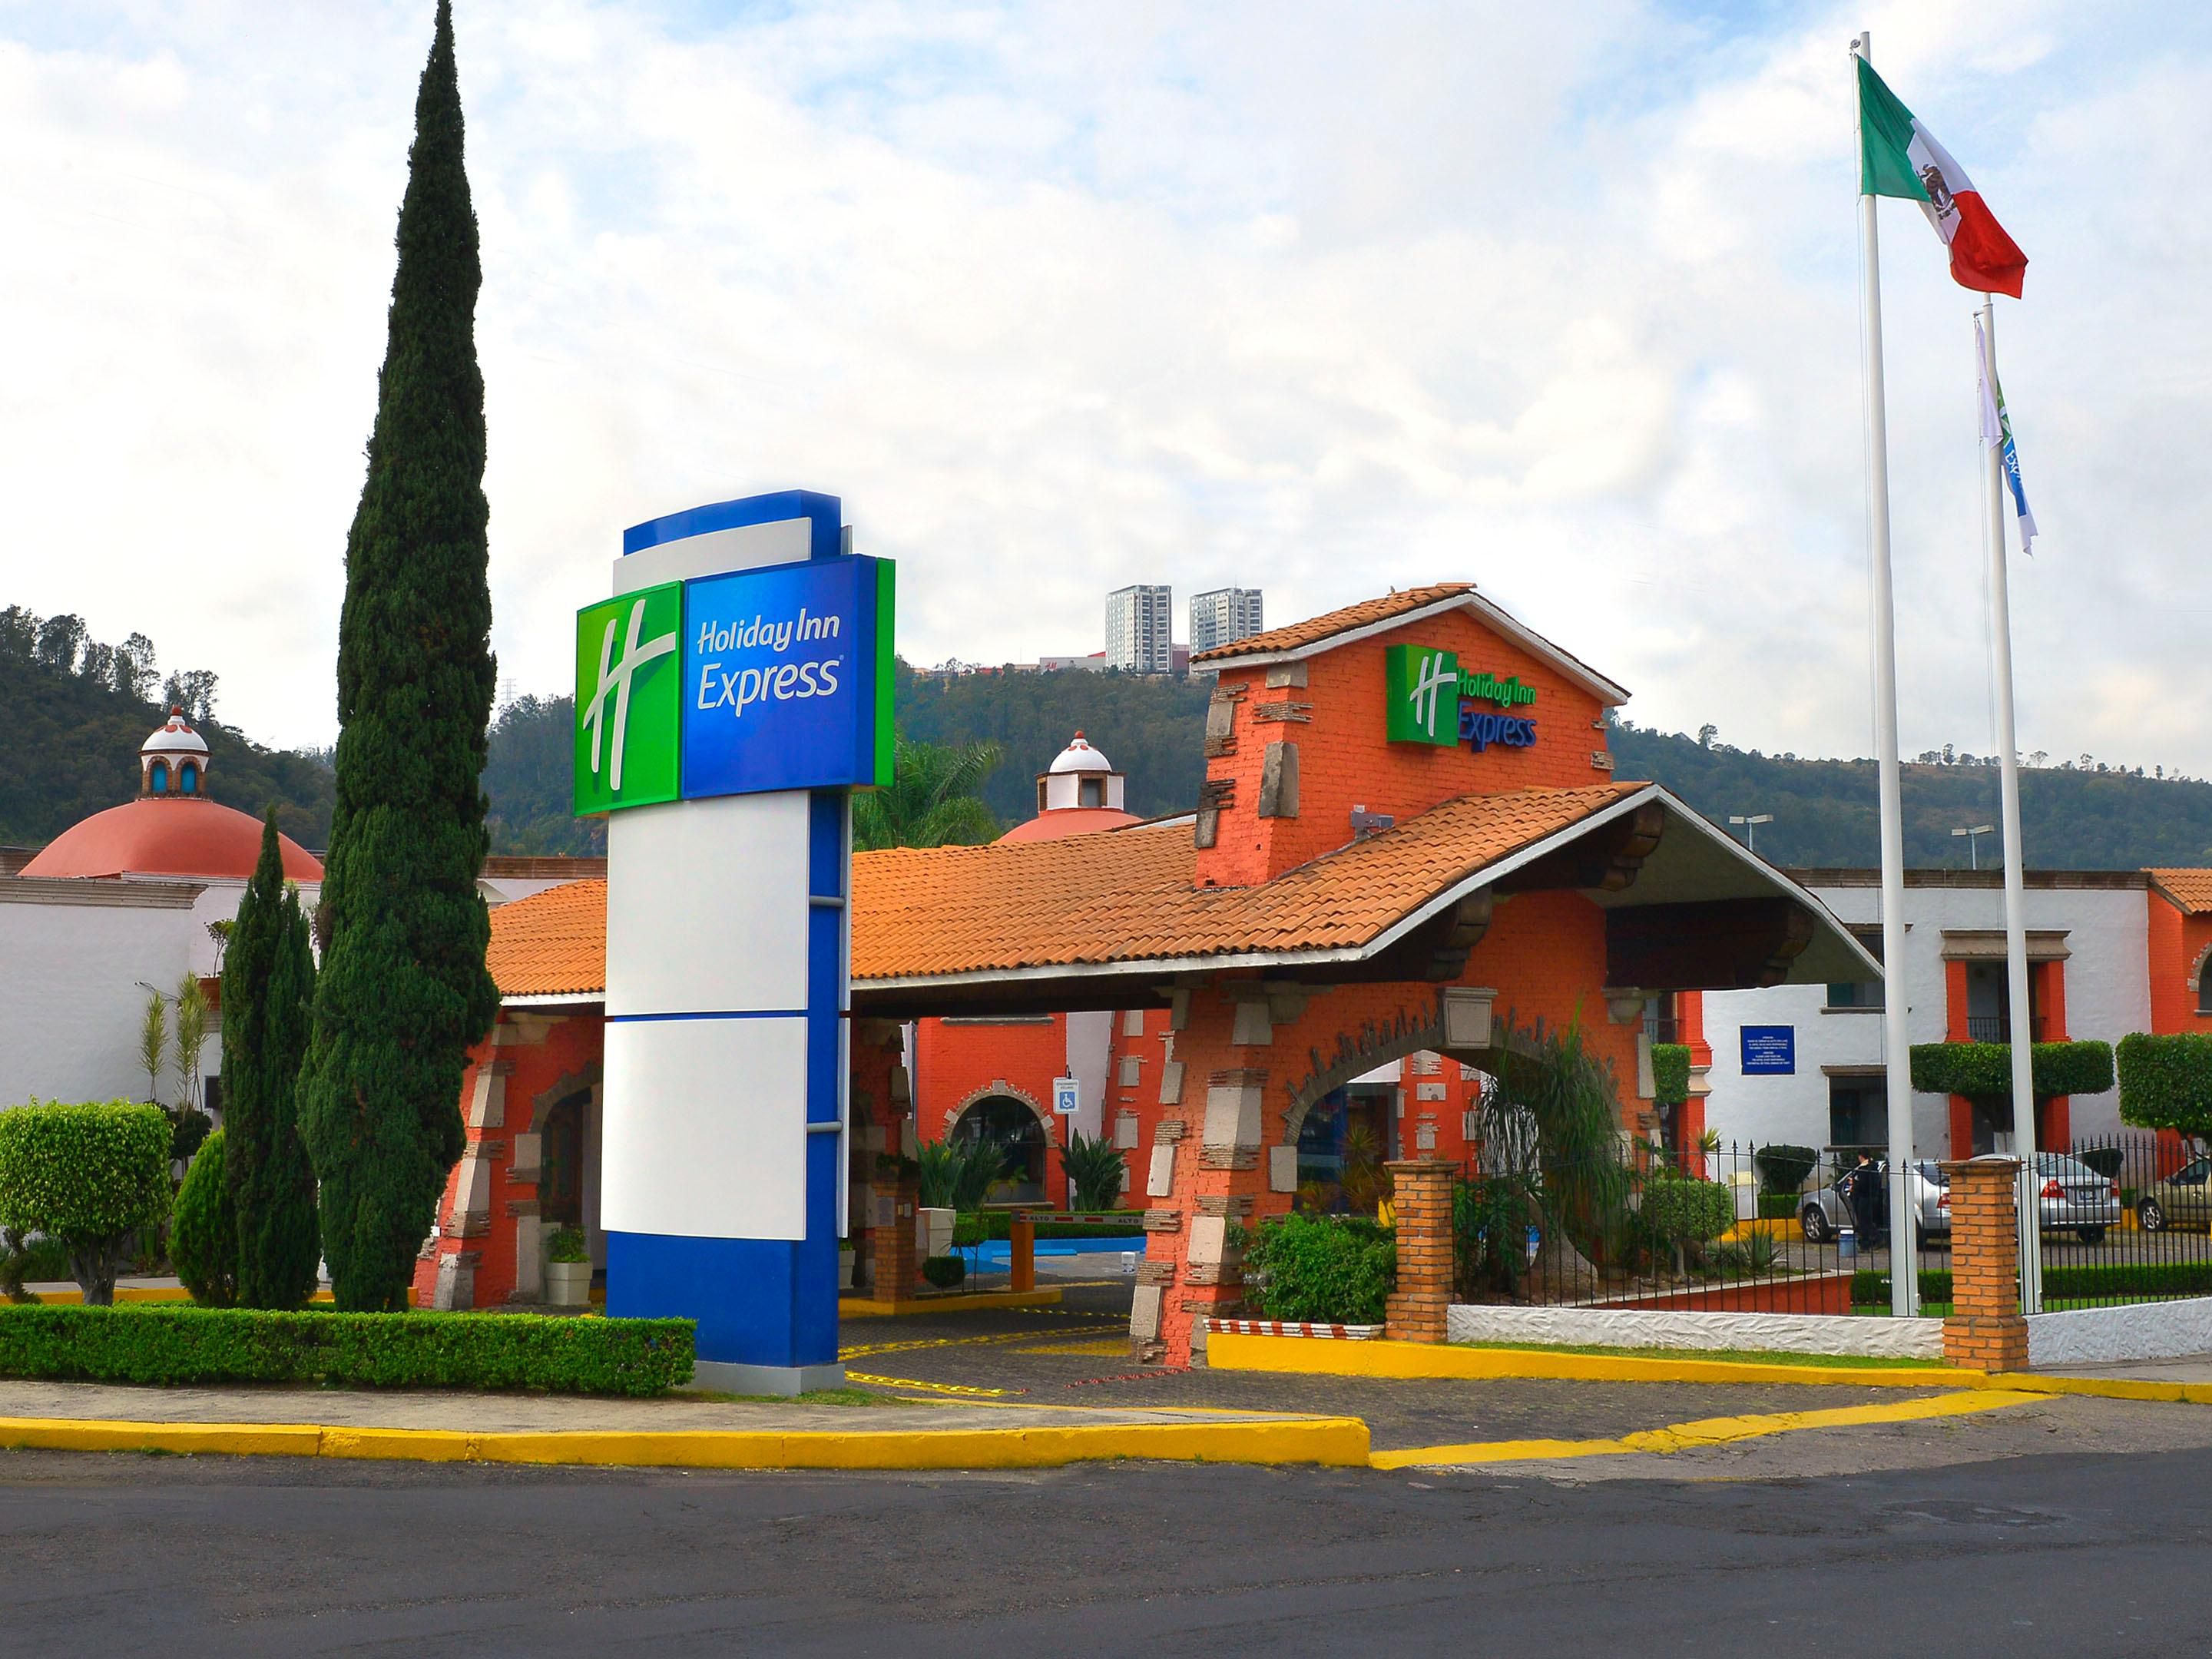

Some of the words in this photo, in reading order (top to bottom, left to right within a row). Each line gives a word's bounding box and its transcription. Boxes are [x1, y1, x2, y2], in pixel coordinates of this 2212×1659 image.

[697, 614, 792, 654] Holiday
[796, 608, 841, 641] Inn
[697, 658, 841, 717] Express
[1457, 668, 1512, 708] Holiday
[1513, 677, 1536, 704] Inn
[1458, 700, 1537, 752] Express
